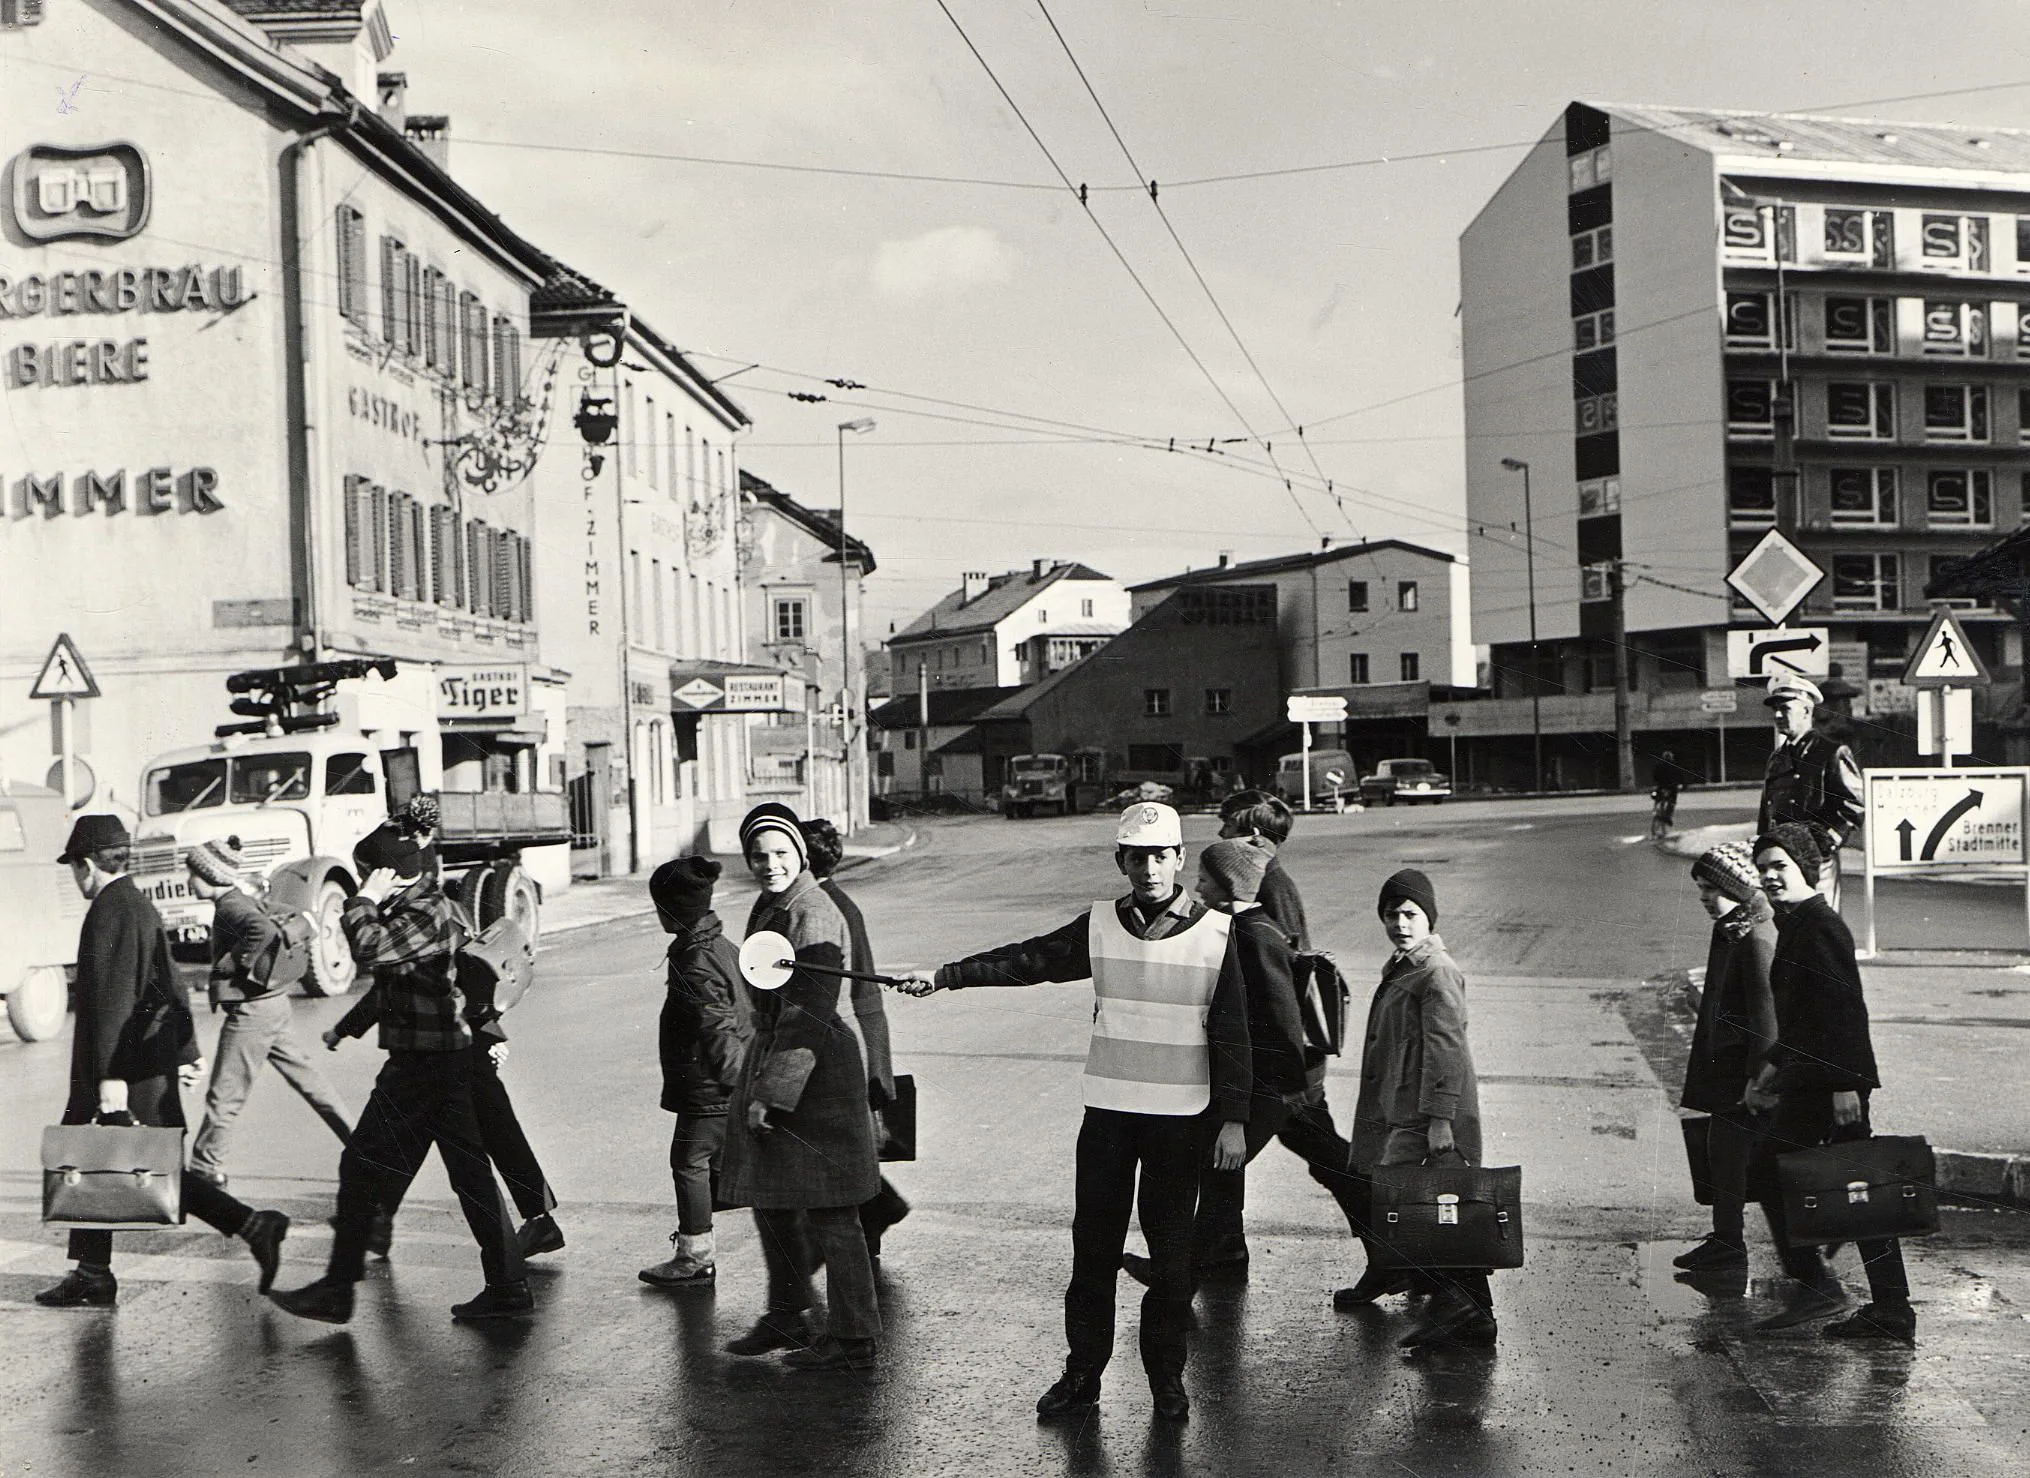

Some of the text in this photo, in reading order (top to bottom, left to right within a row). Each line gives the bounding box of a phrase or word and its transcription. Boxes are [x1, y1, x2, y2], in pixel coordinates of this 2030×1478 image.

[12, 337, 149, 386] BIERE
[585, 520, 601, 635] ZIMMER
[440, 677, 518, 712] Tiger
[729, 681, 778, 692] RESTAURANT
[730, 694, 778, 704] ZIMMER
[1963, 820, 2018, 835] Brenner
[1948, 836, 2019, 852] Stadtmitte
